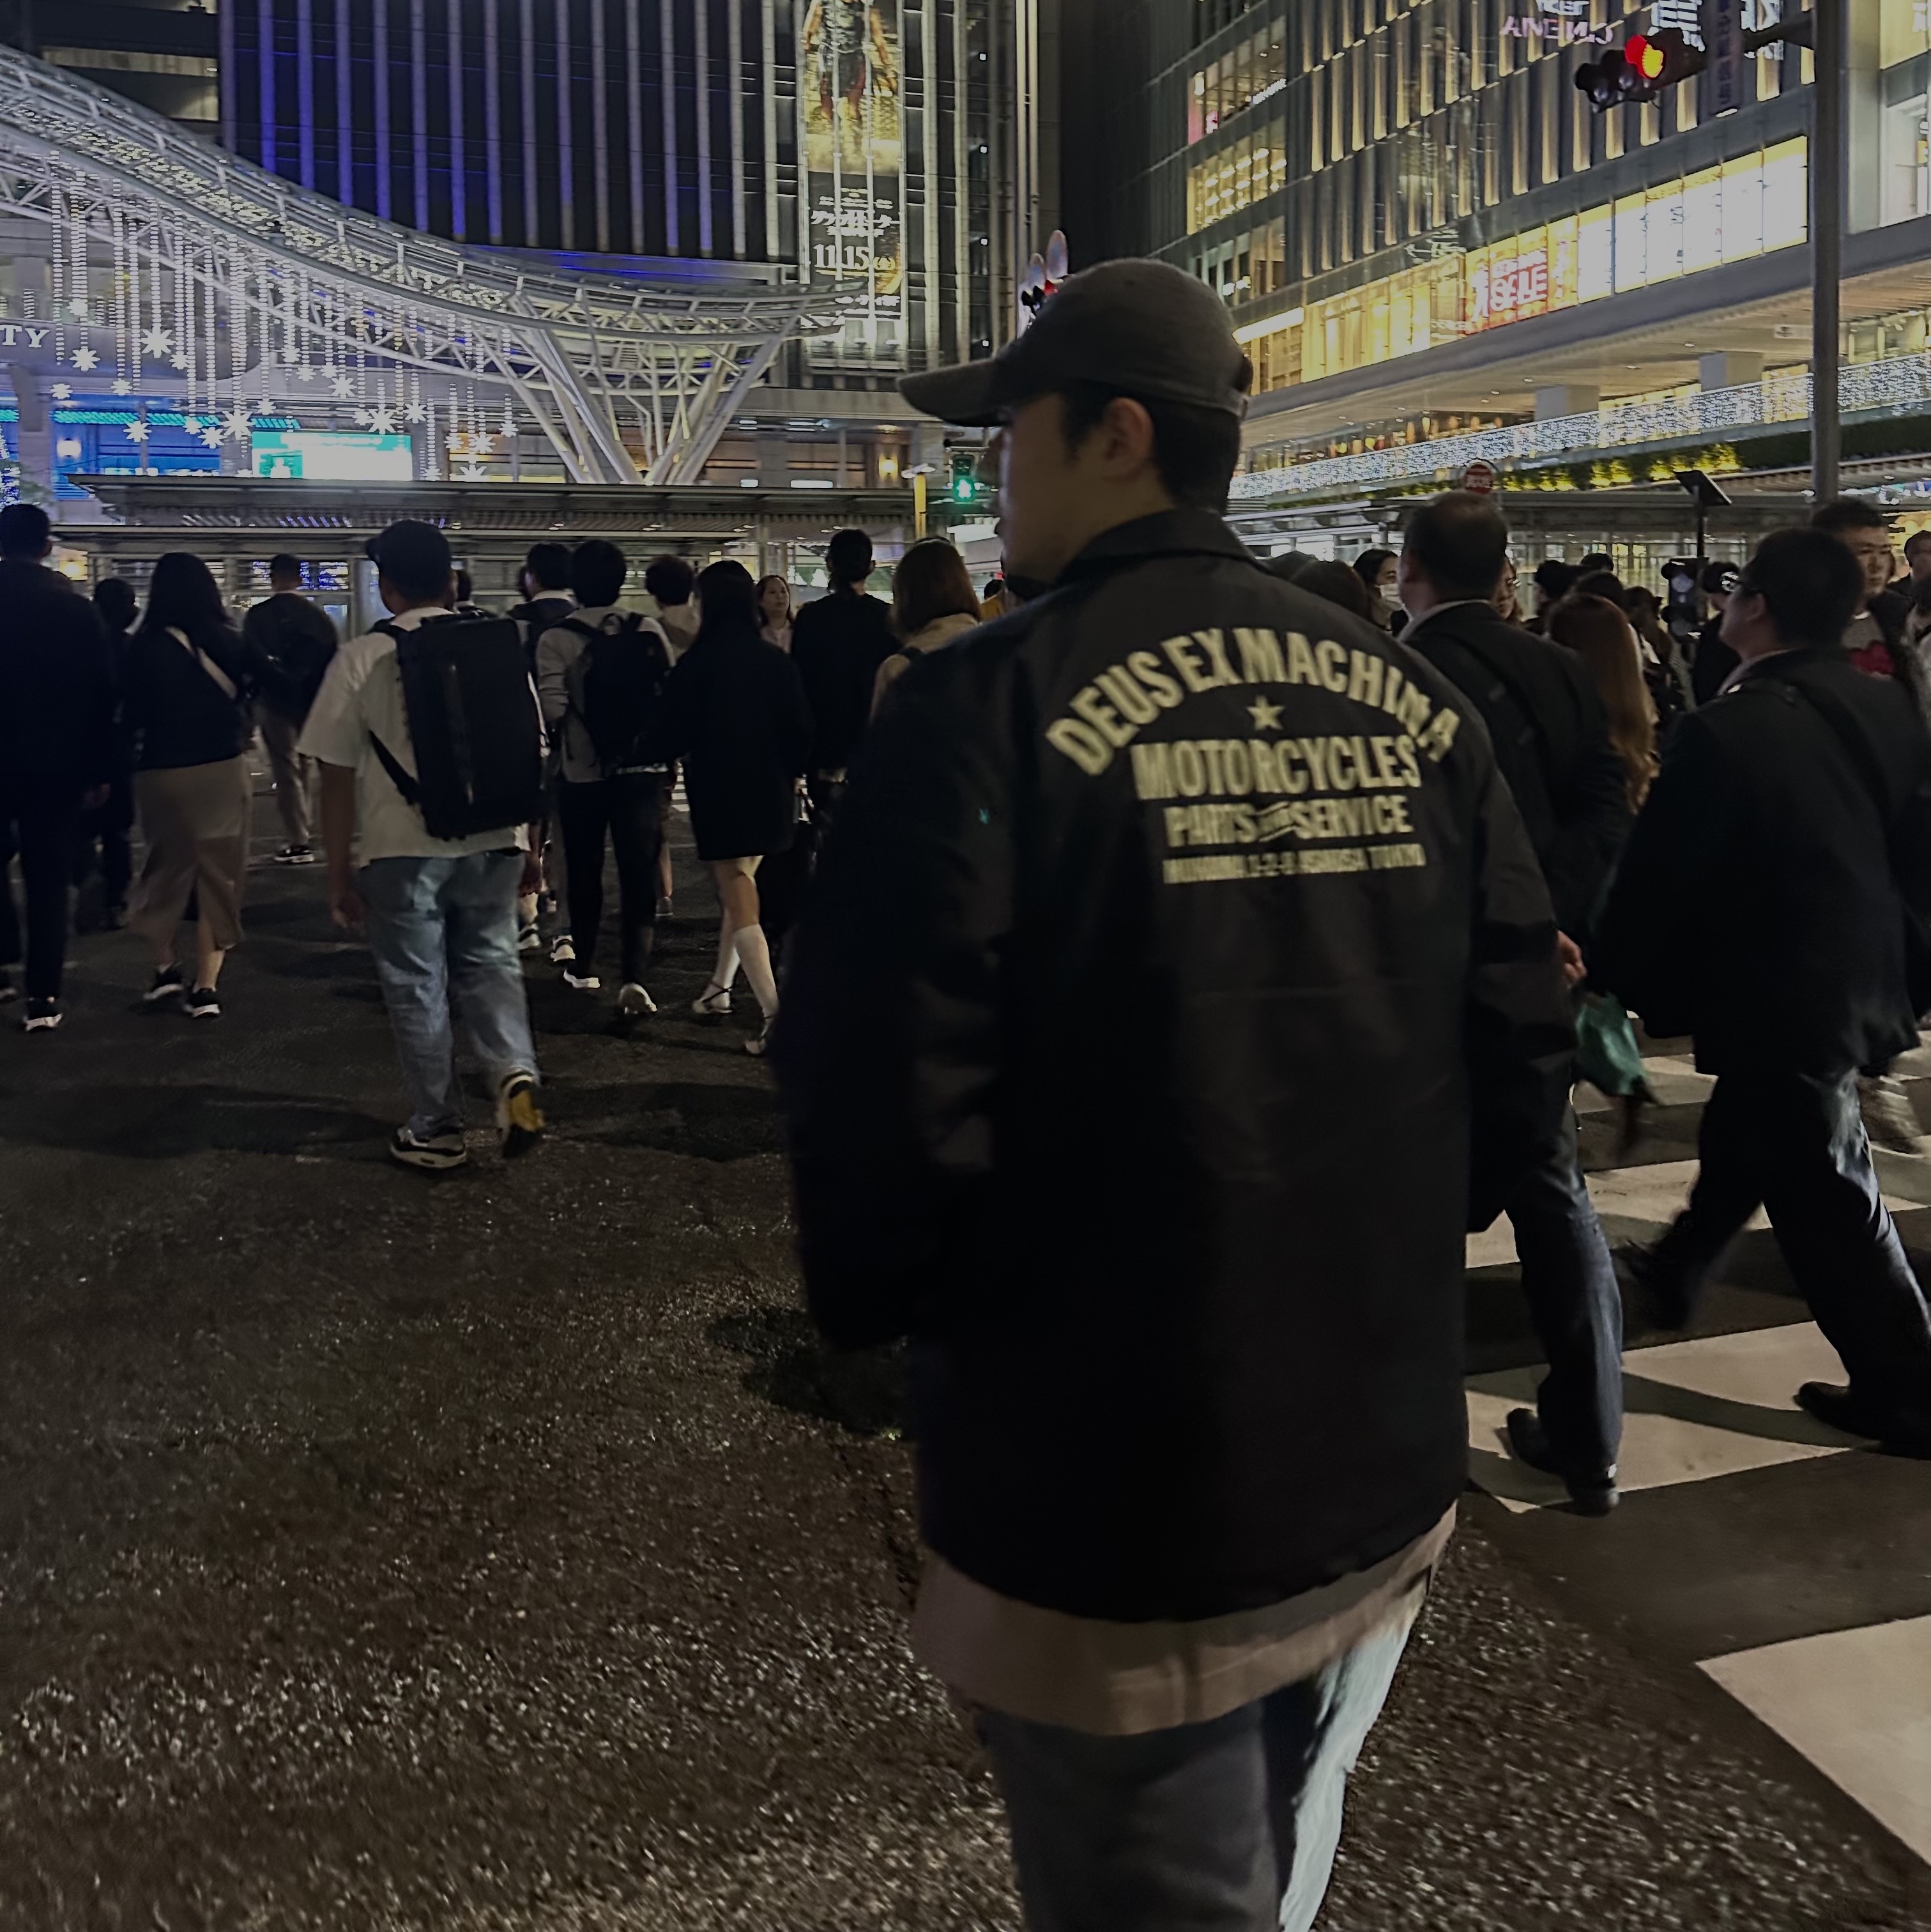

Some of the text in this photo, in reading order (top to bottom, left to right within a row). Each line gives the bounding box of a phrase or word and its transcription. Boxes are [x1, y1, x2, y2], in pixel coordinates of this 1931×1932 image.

[1046, 628, 1460, 775] DEUS EX MACHINA
[1130, 735, 1421, 800] MOTORCYCLES
[1163, 802, 1257, 847] PARTS
[1288, 795, 1414, 839] SERVICE
